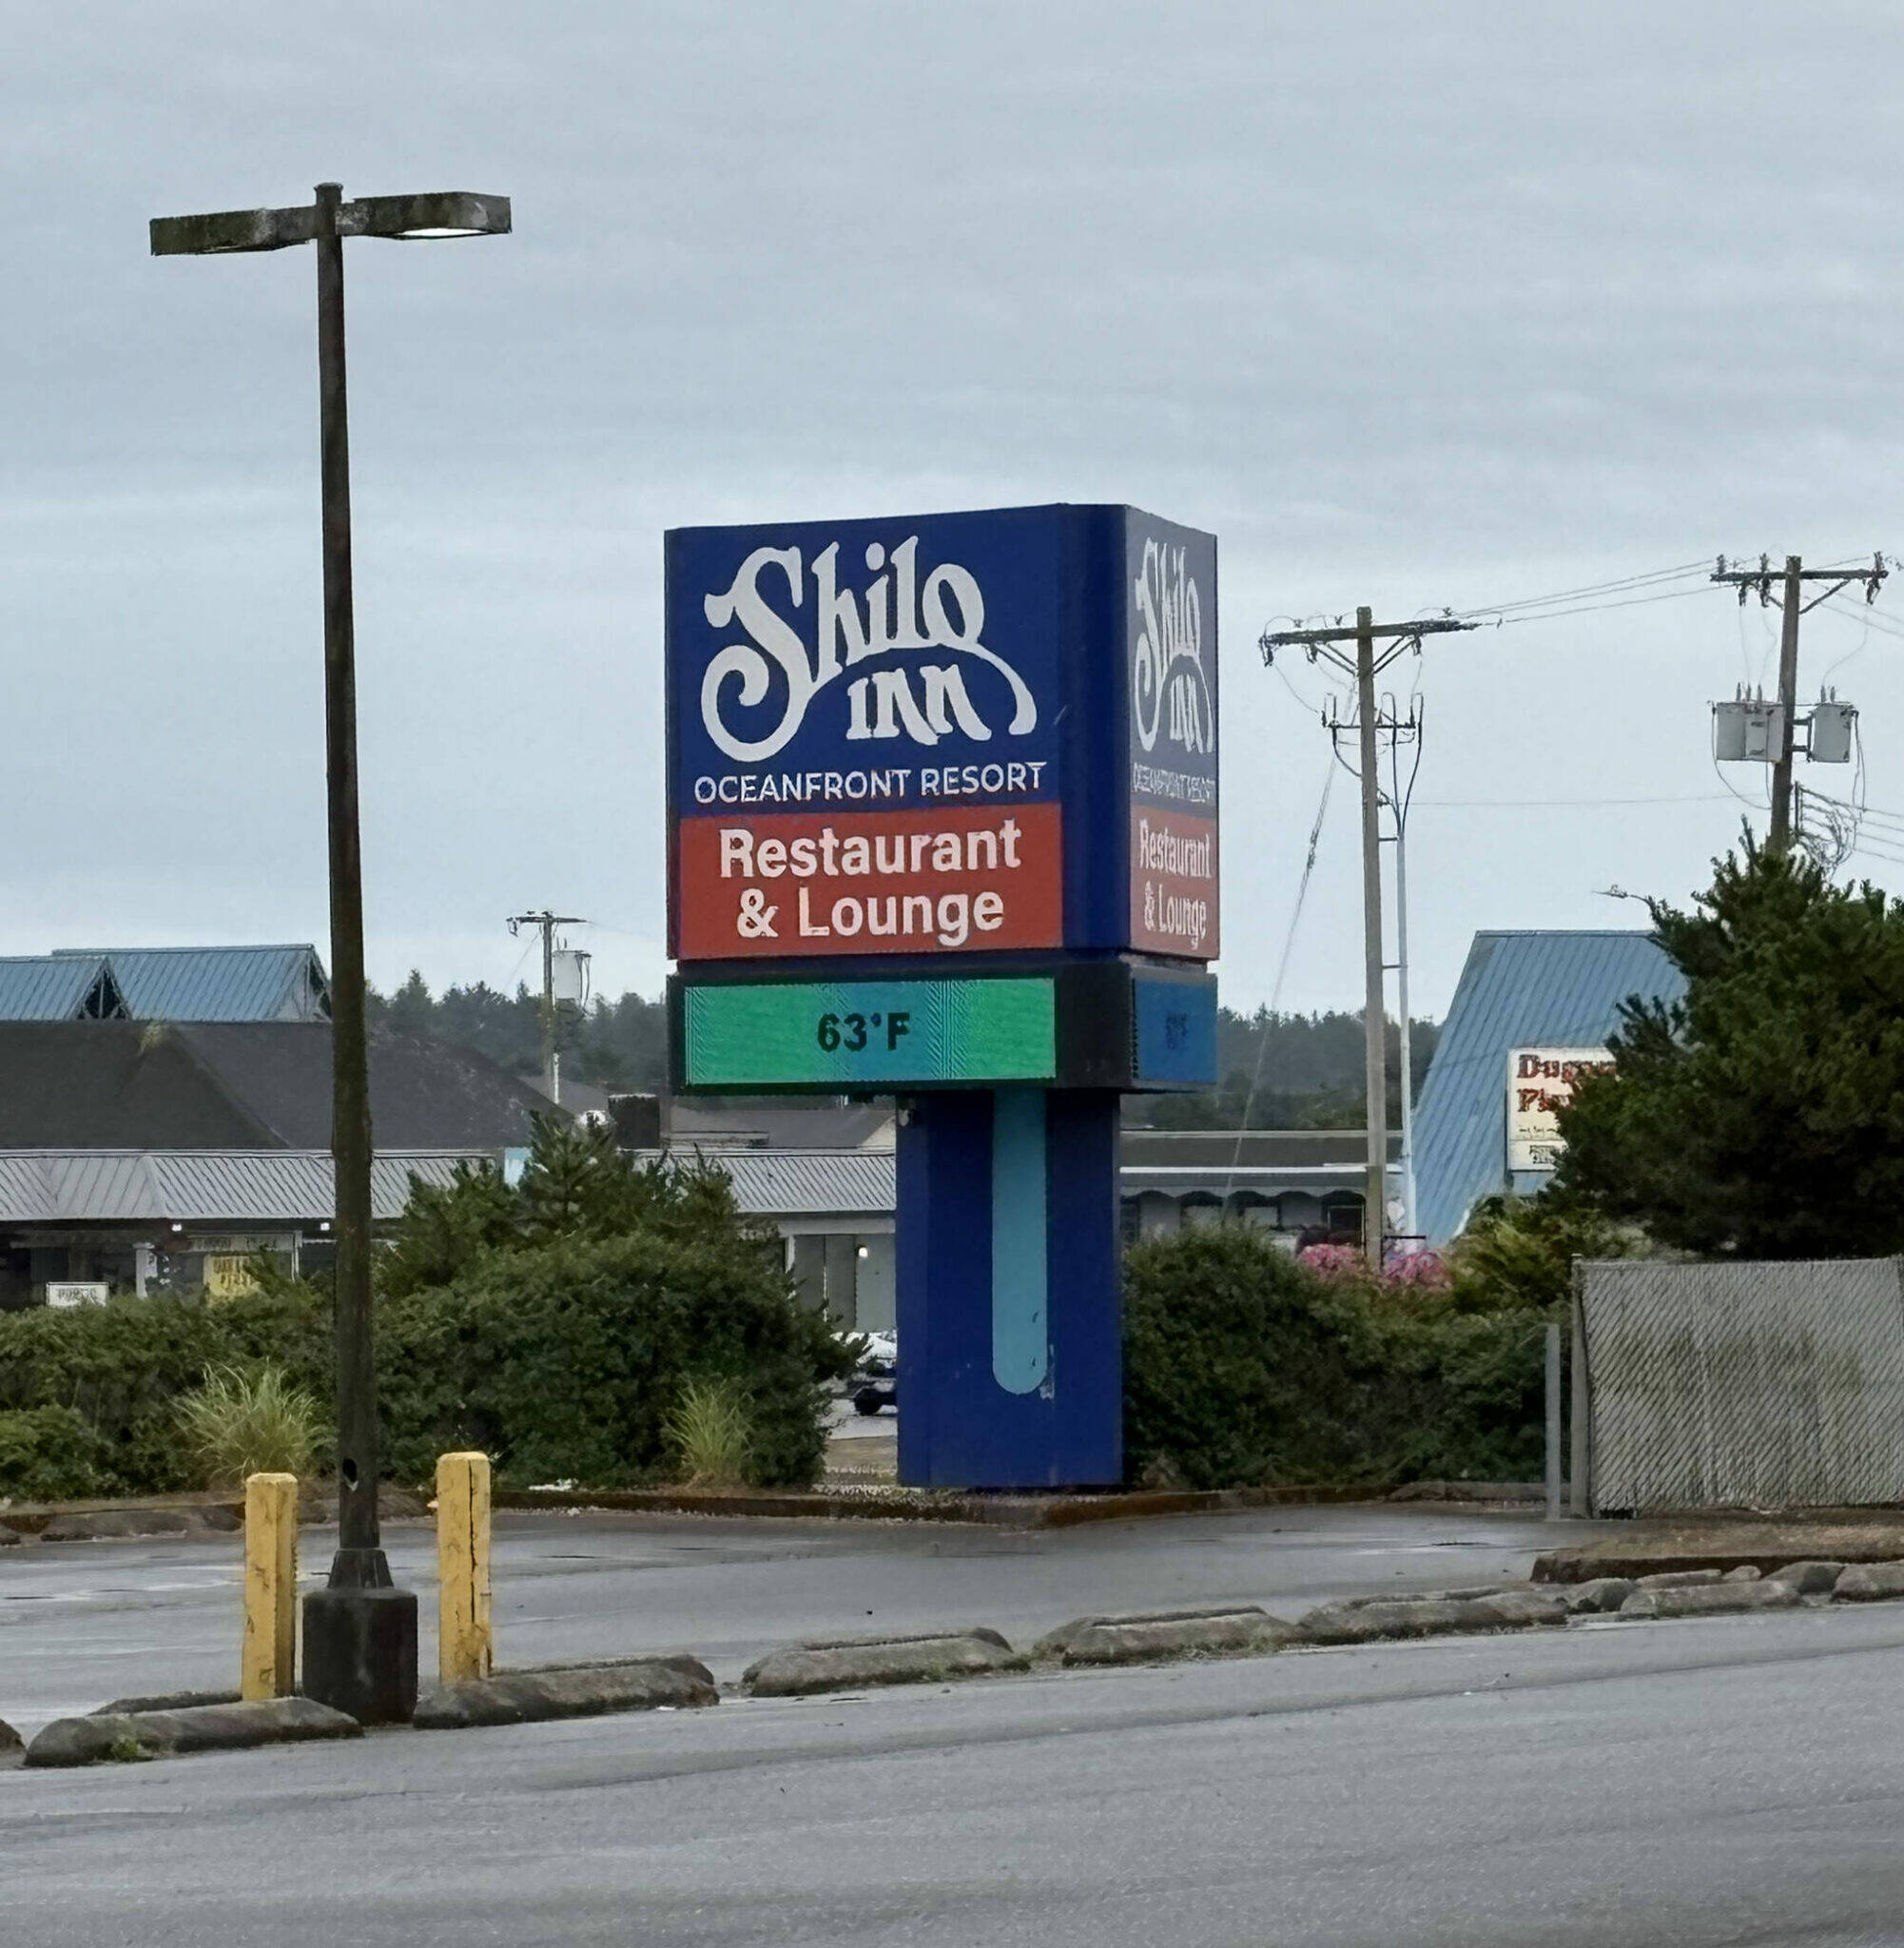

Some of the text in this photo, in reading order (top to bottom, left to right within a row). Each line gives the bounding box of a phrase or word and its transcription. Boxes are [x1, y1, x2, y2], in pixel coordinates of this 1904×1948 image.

[701, 535, 1038, 762] Shilo
[1135, 536, 1213, 752] Shilo
[694, 761, 1047, 804] OCEANFRONT RESORT
[720, 818, 1022, 878] Restaurant
[1139, 818, 1213, 880] Restaurant
[737, 886, 1004, 947] & Lounge
[1144, 880, 1207, 950] & Lounge
